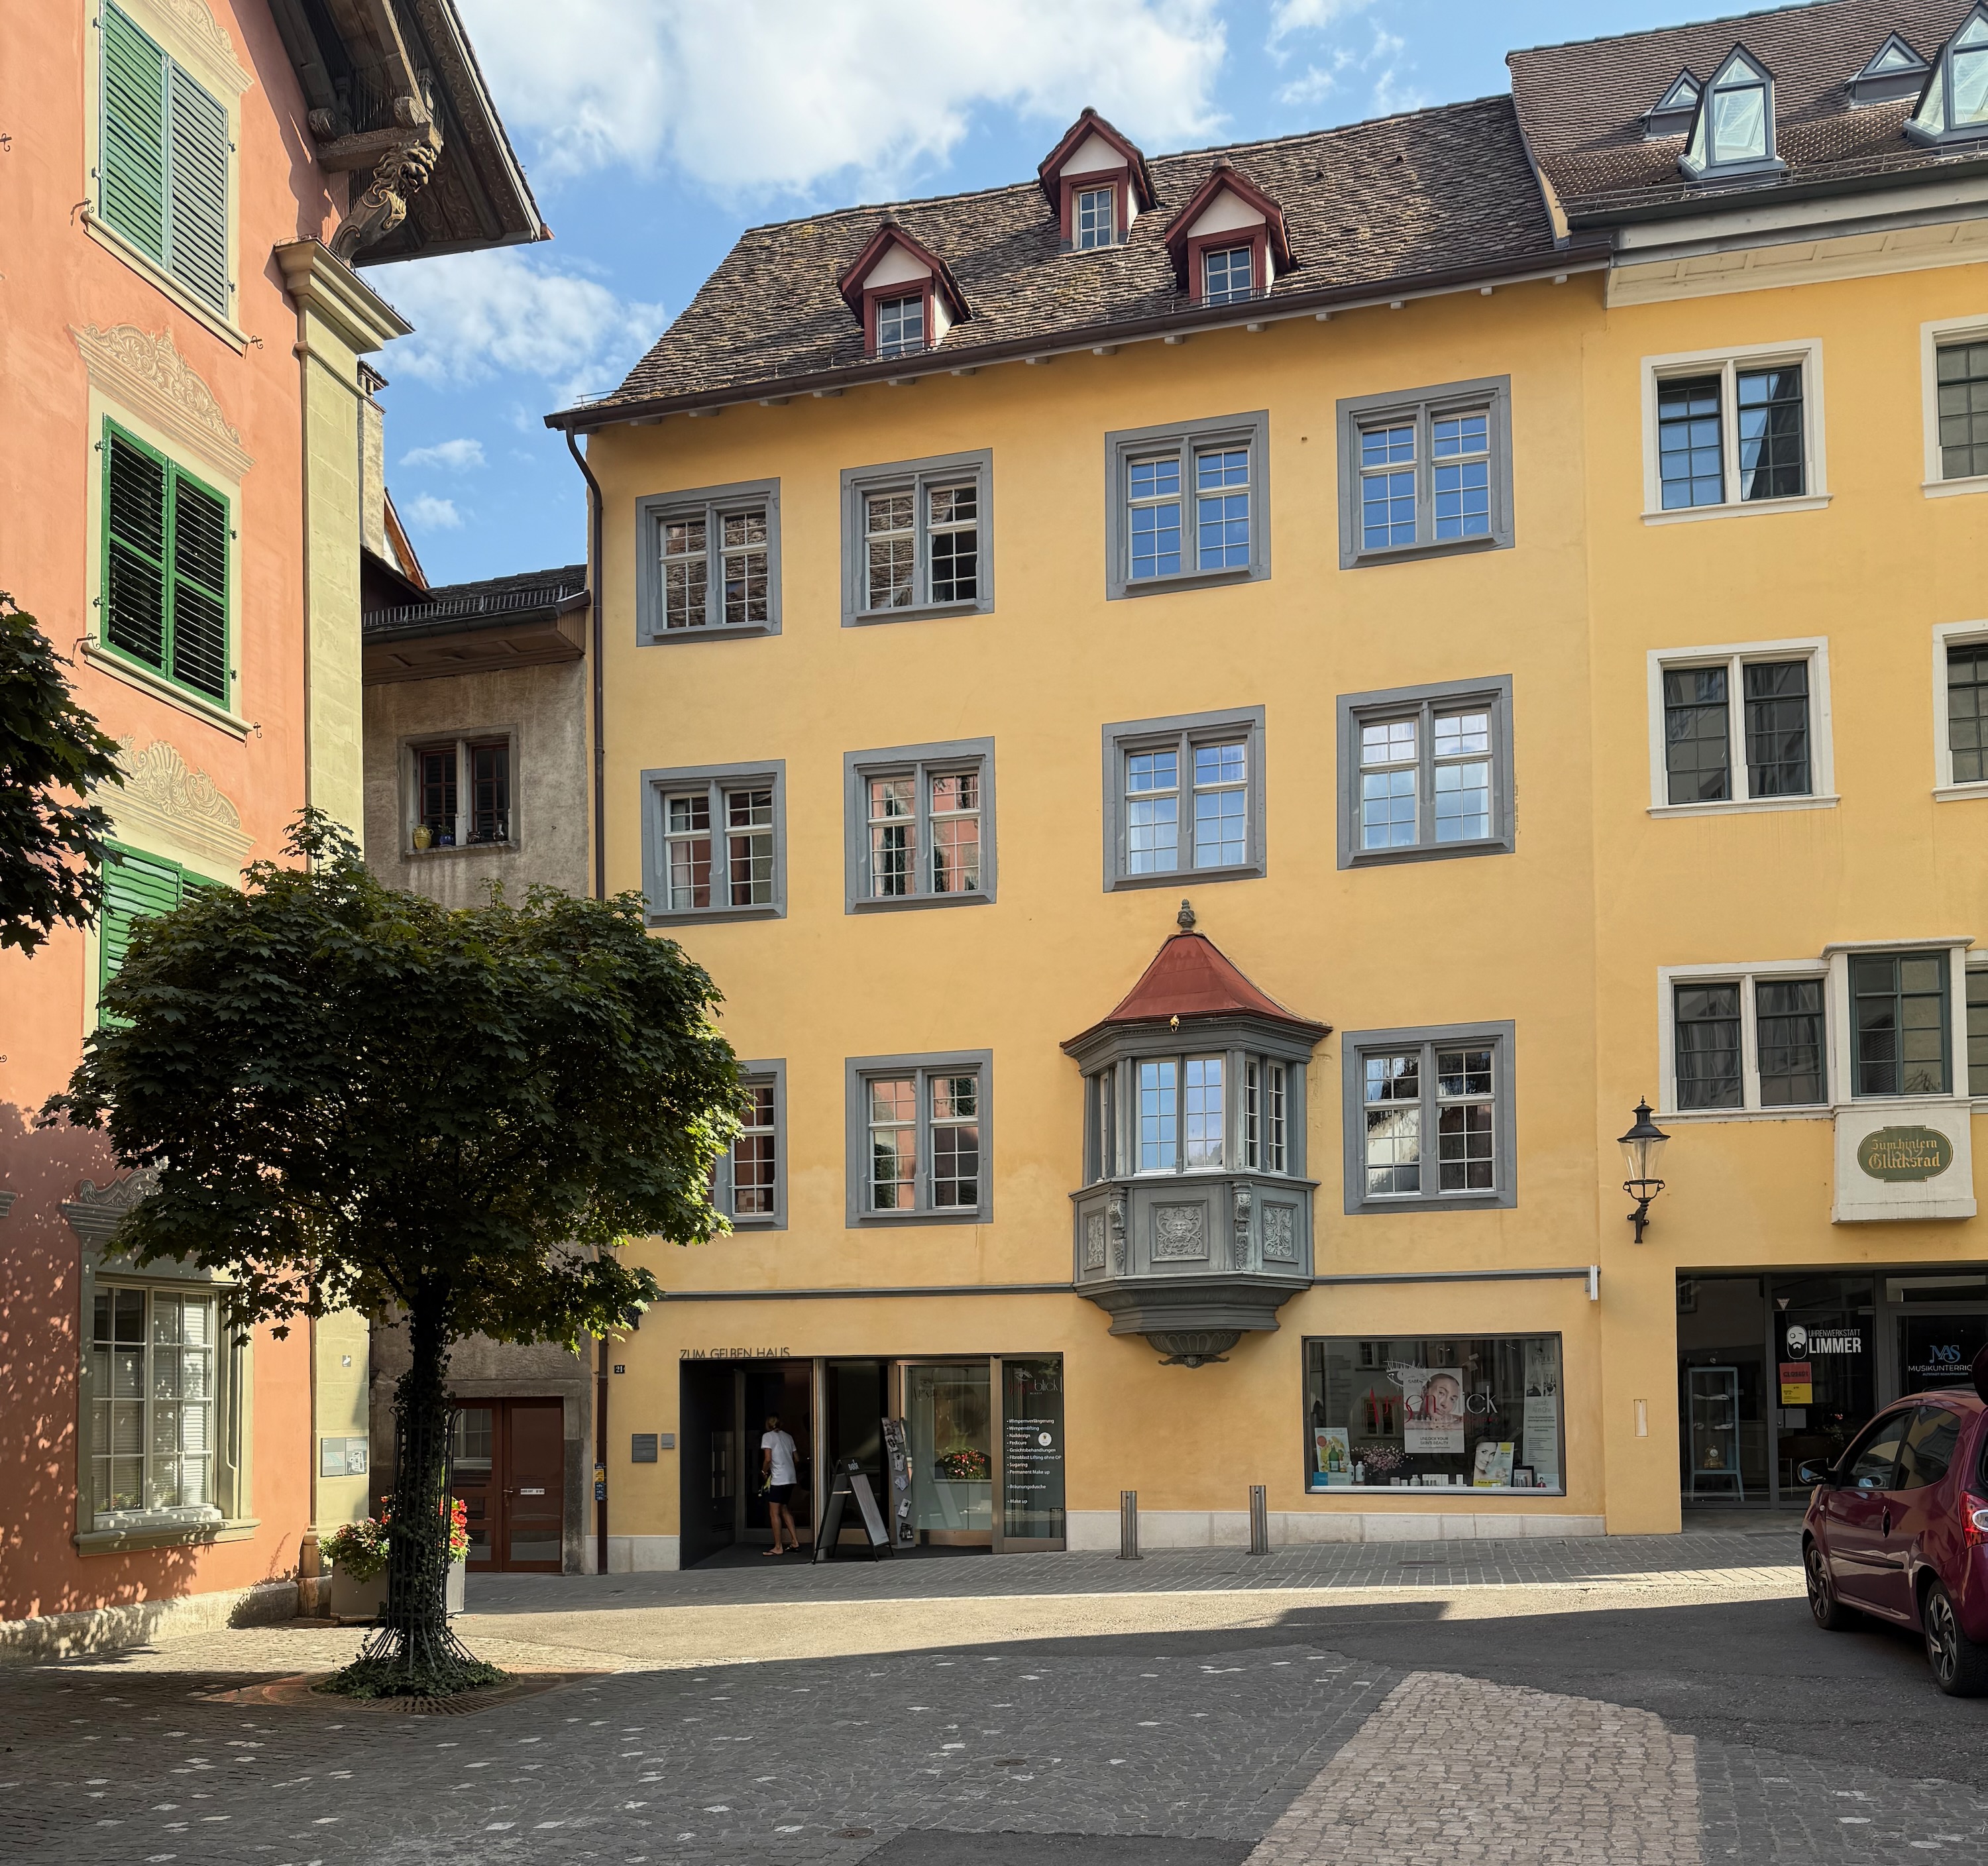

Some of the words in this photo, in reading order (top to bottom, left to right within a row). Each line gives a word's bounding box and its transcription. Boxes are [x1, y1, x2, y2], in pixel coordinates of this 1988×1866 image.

[1808, 1329, 1861, 1337] UHRENWERKSTATT
[1808, 1337, 1861, 1353] LIMMER
[680, 1349, 705, 1359] ZUM
[710, 1348, 752, 1358] GELBEN
[757, 1347, 790, 1358] HAUS
[1929, 1345, 1961, 1363] MAS
